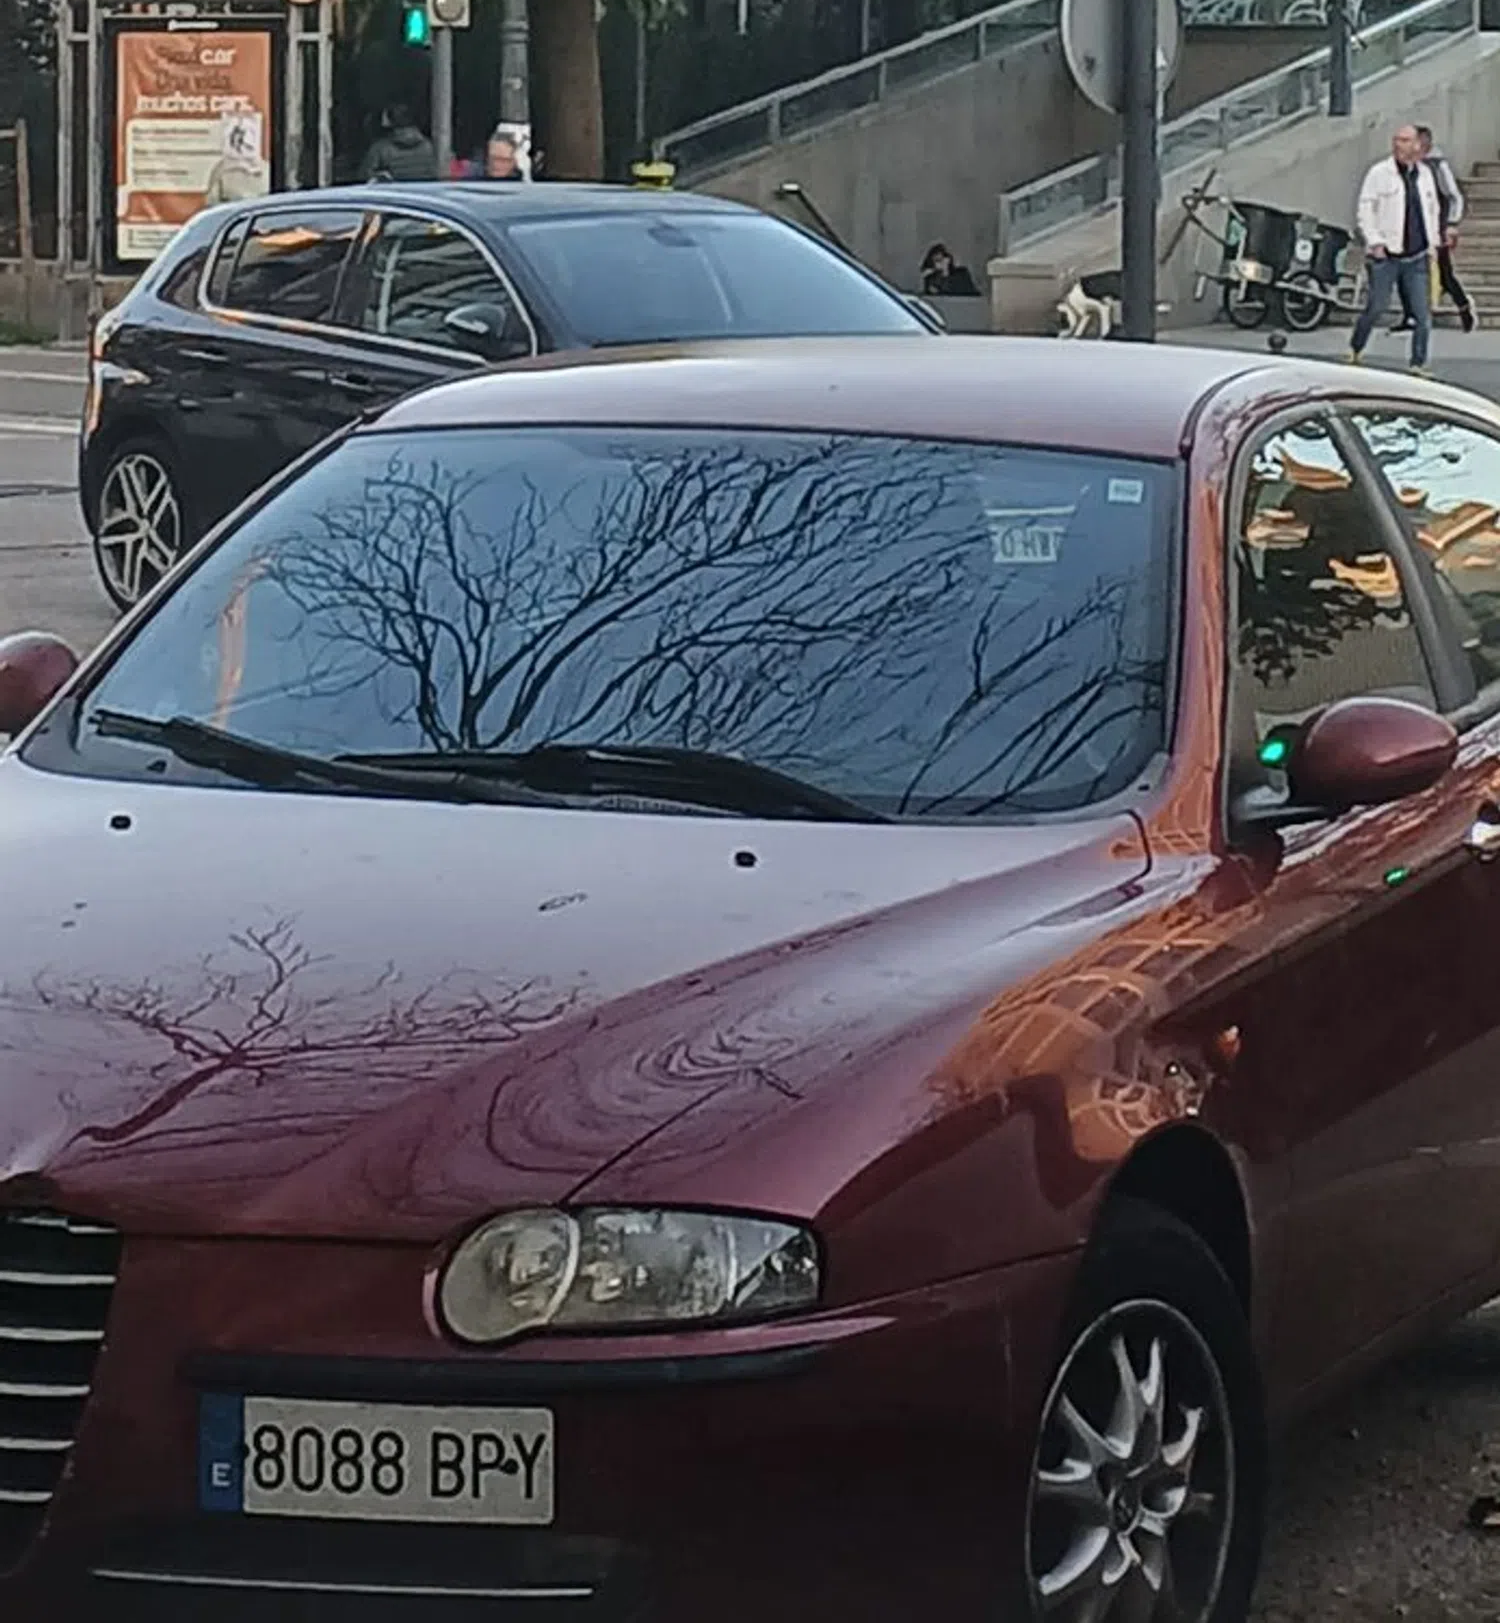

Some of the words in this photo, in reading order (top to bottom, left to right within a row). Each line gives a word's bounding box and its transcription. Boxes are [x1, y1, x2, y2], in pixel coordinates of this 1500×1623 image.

[136, 91, 207, 113] muchos
[211, 1462, 232, 1487] E
[252, 1424, 405, 1497] 8088
[430, 1431, 546, 1500] BPY
